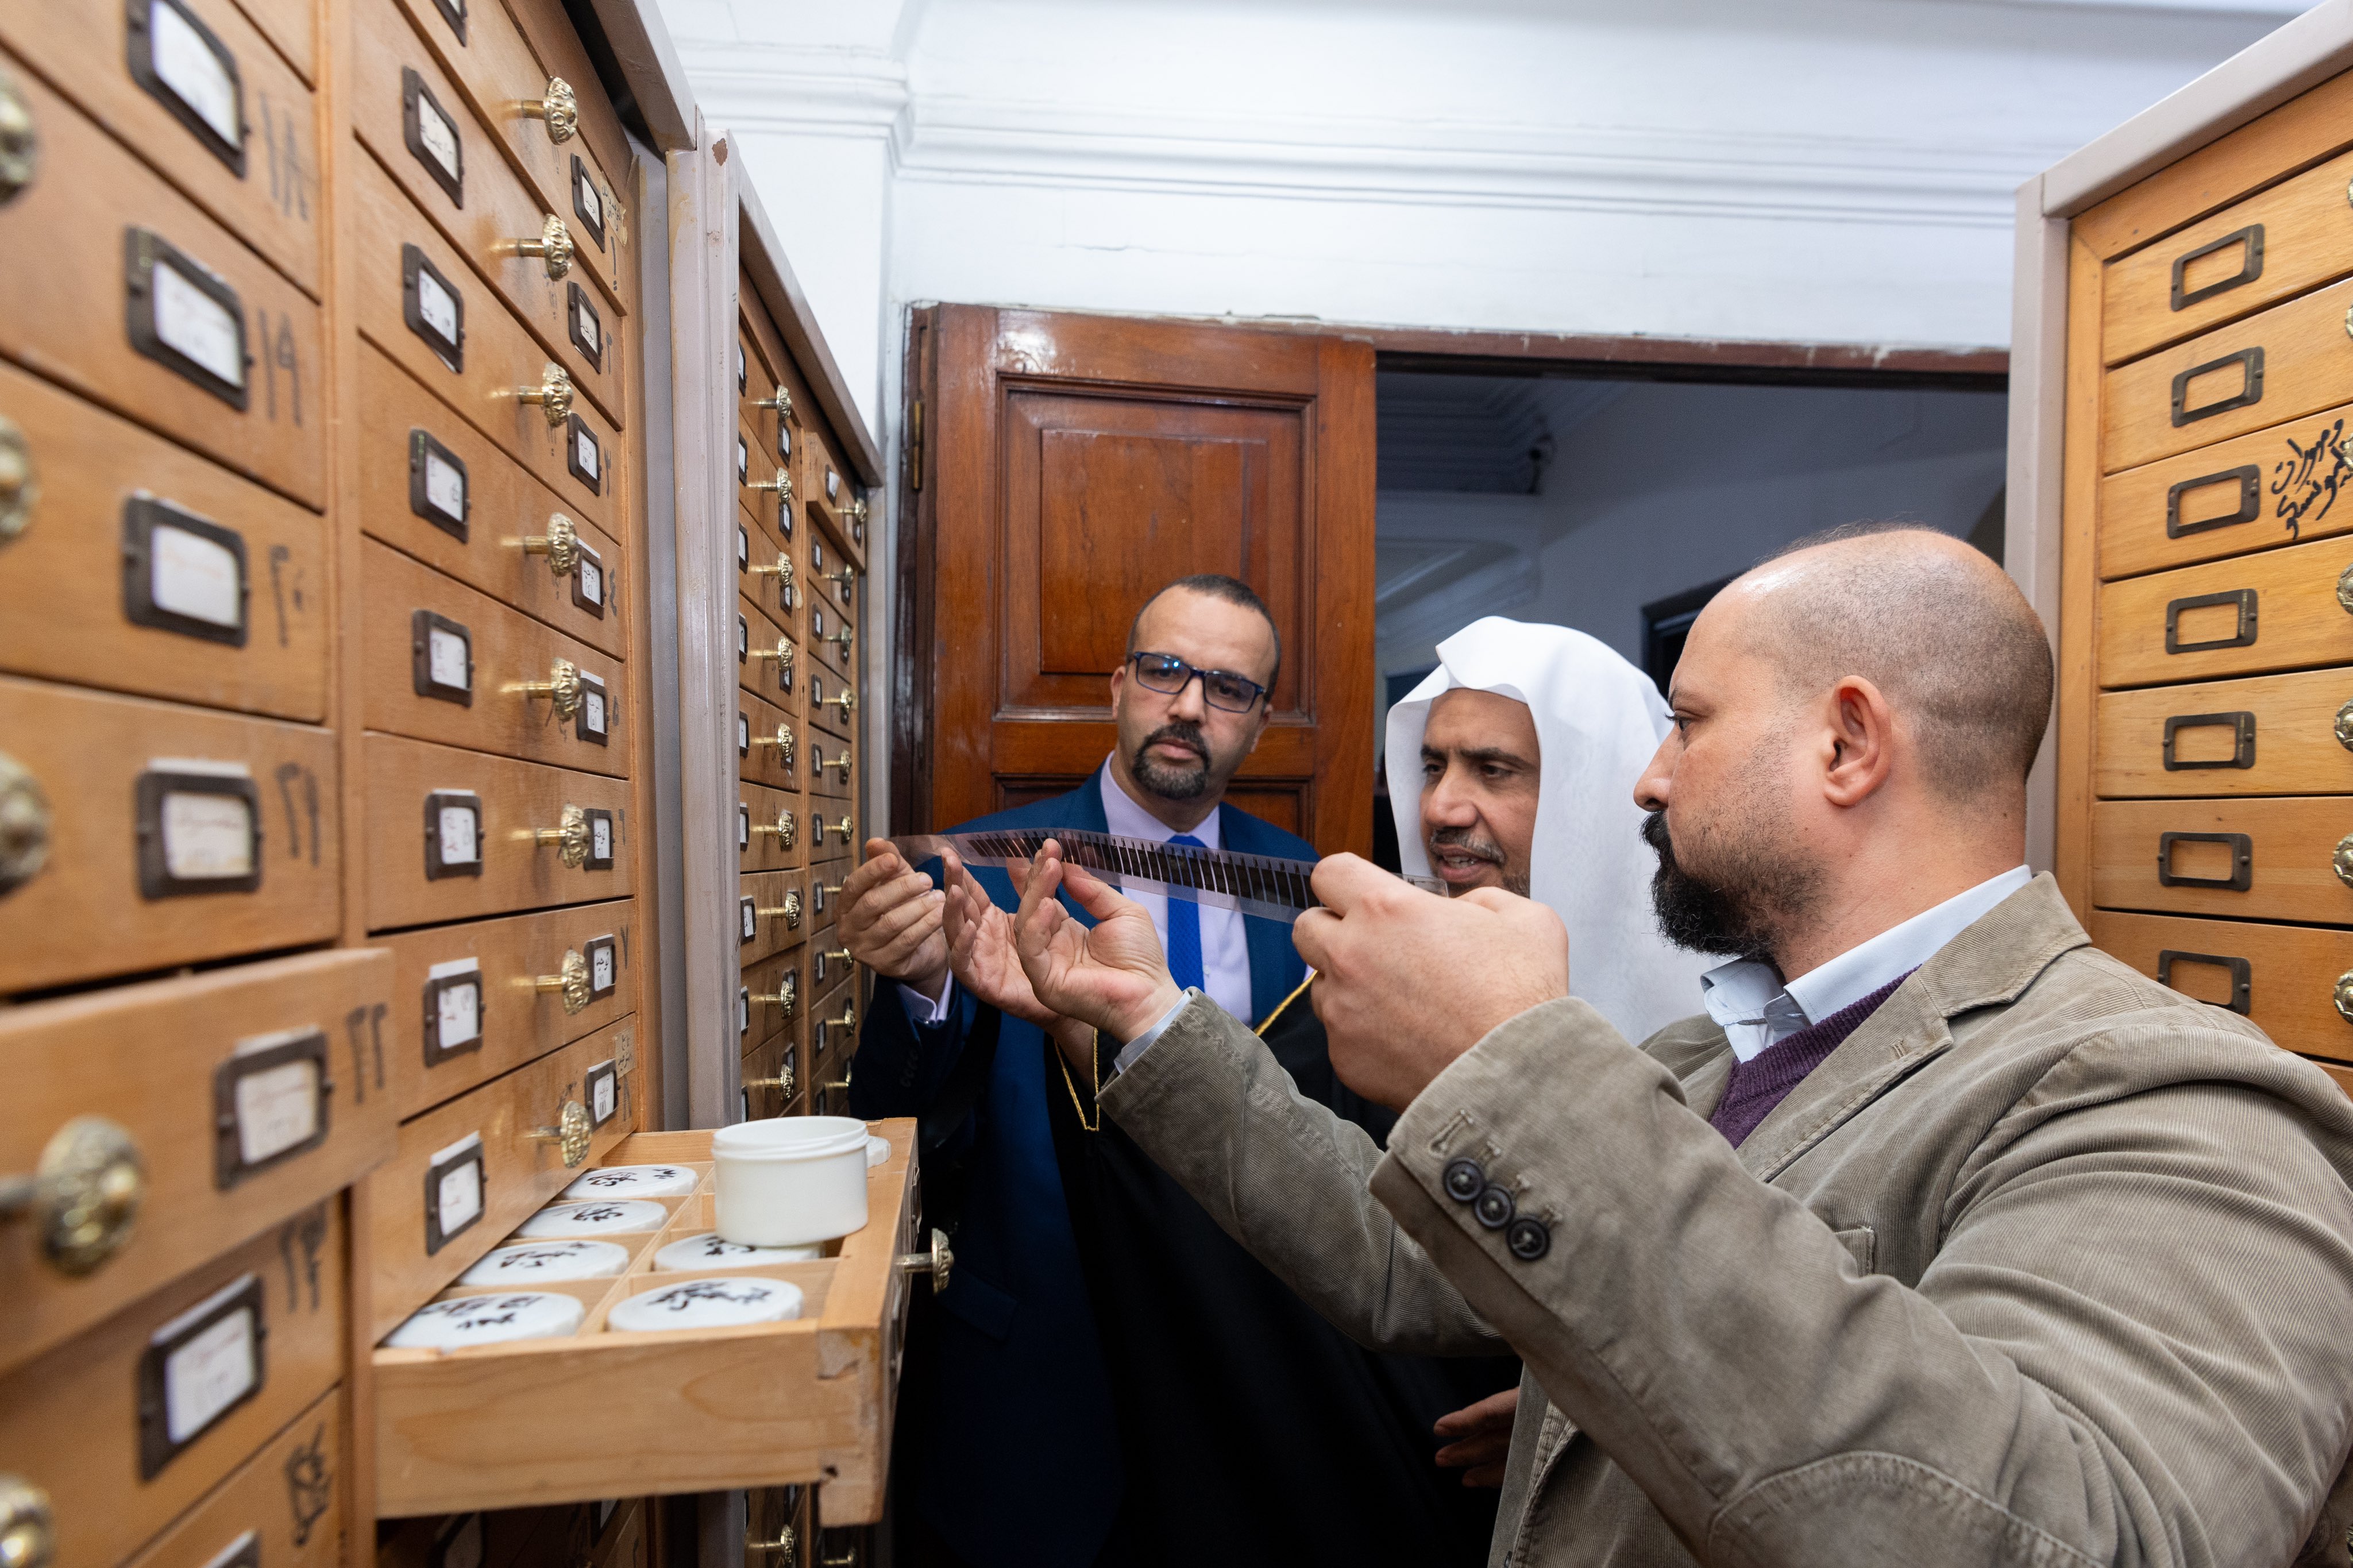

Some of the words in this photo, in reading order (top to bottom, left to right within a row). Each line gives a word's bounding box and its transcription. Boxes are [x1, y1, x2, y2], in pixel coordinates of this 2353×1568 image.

[259, 309, 302, 426] ١٩
[620, 924, 629, 970] ٧
[346, 1003, 388, 1103] ٢٢
